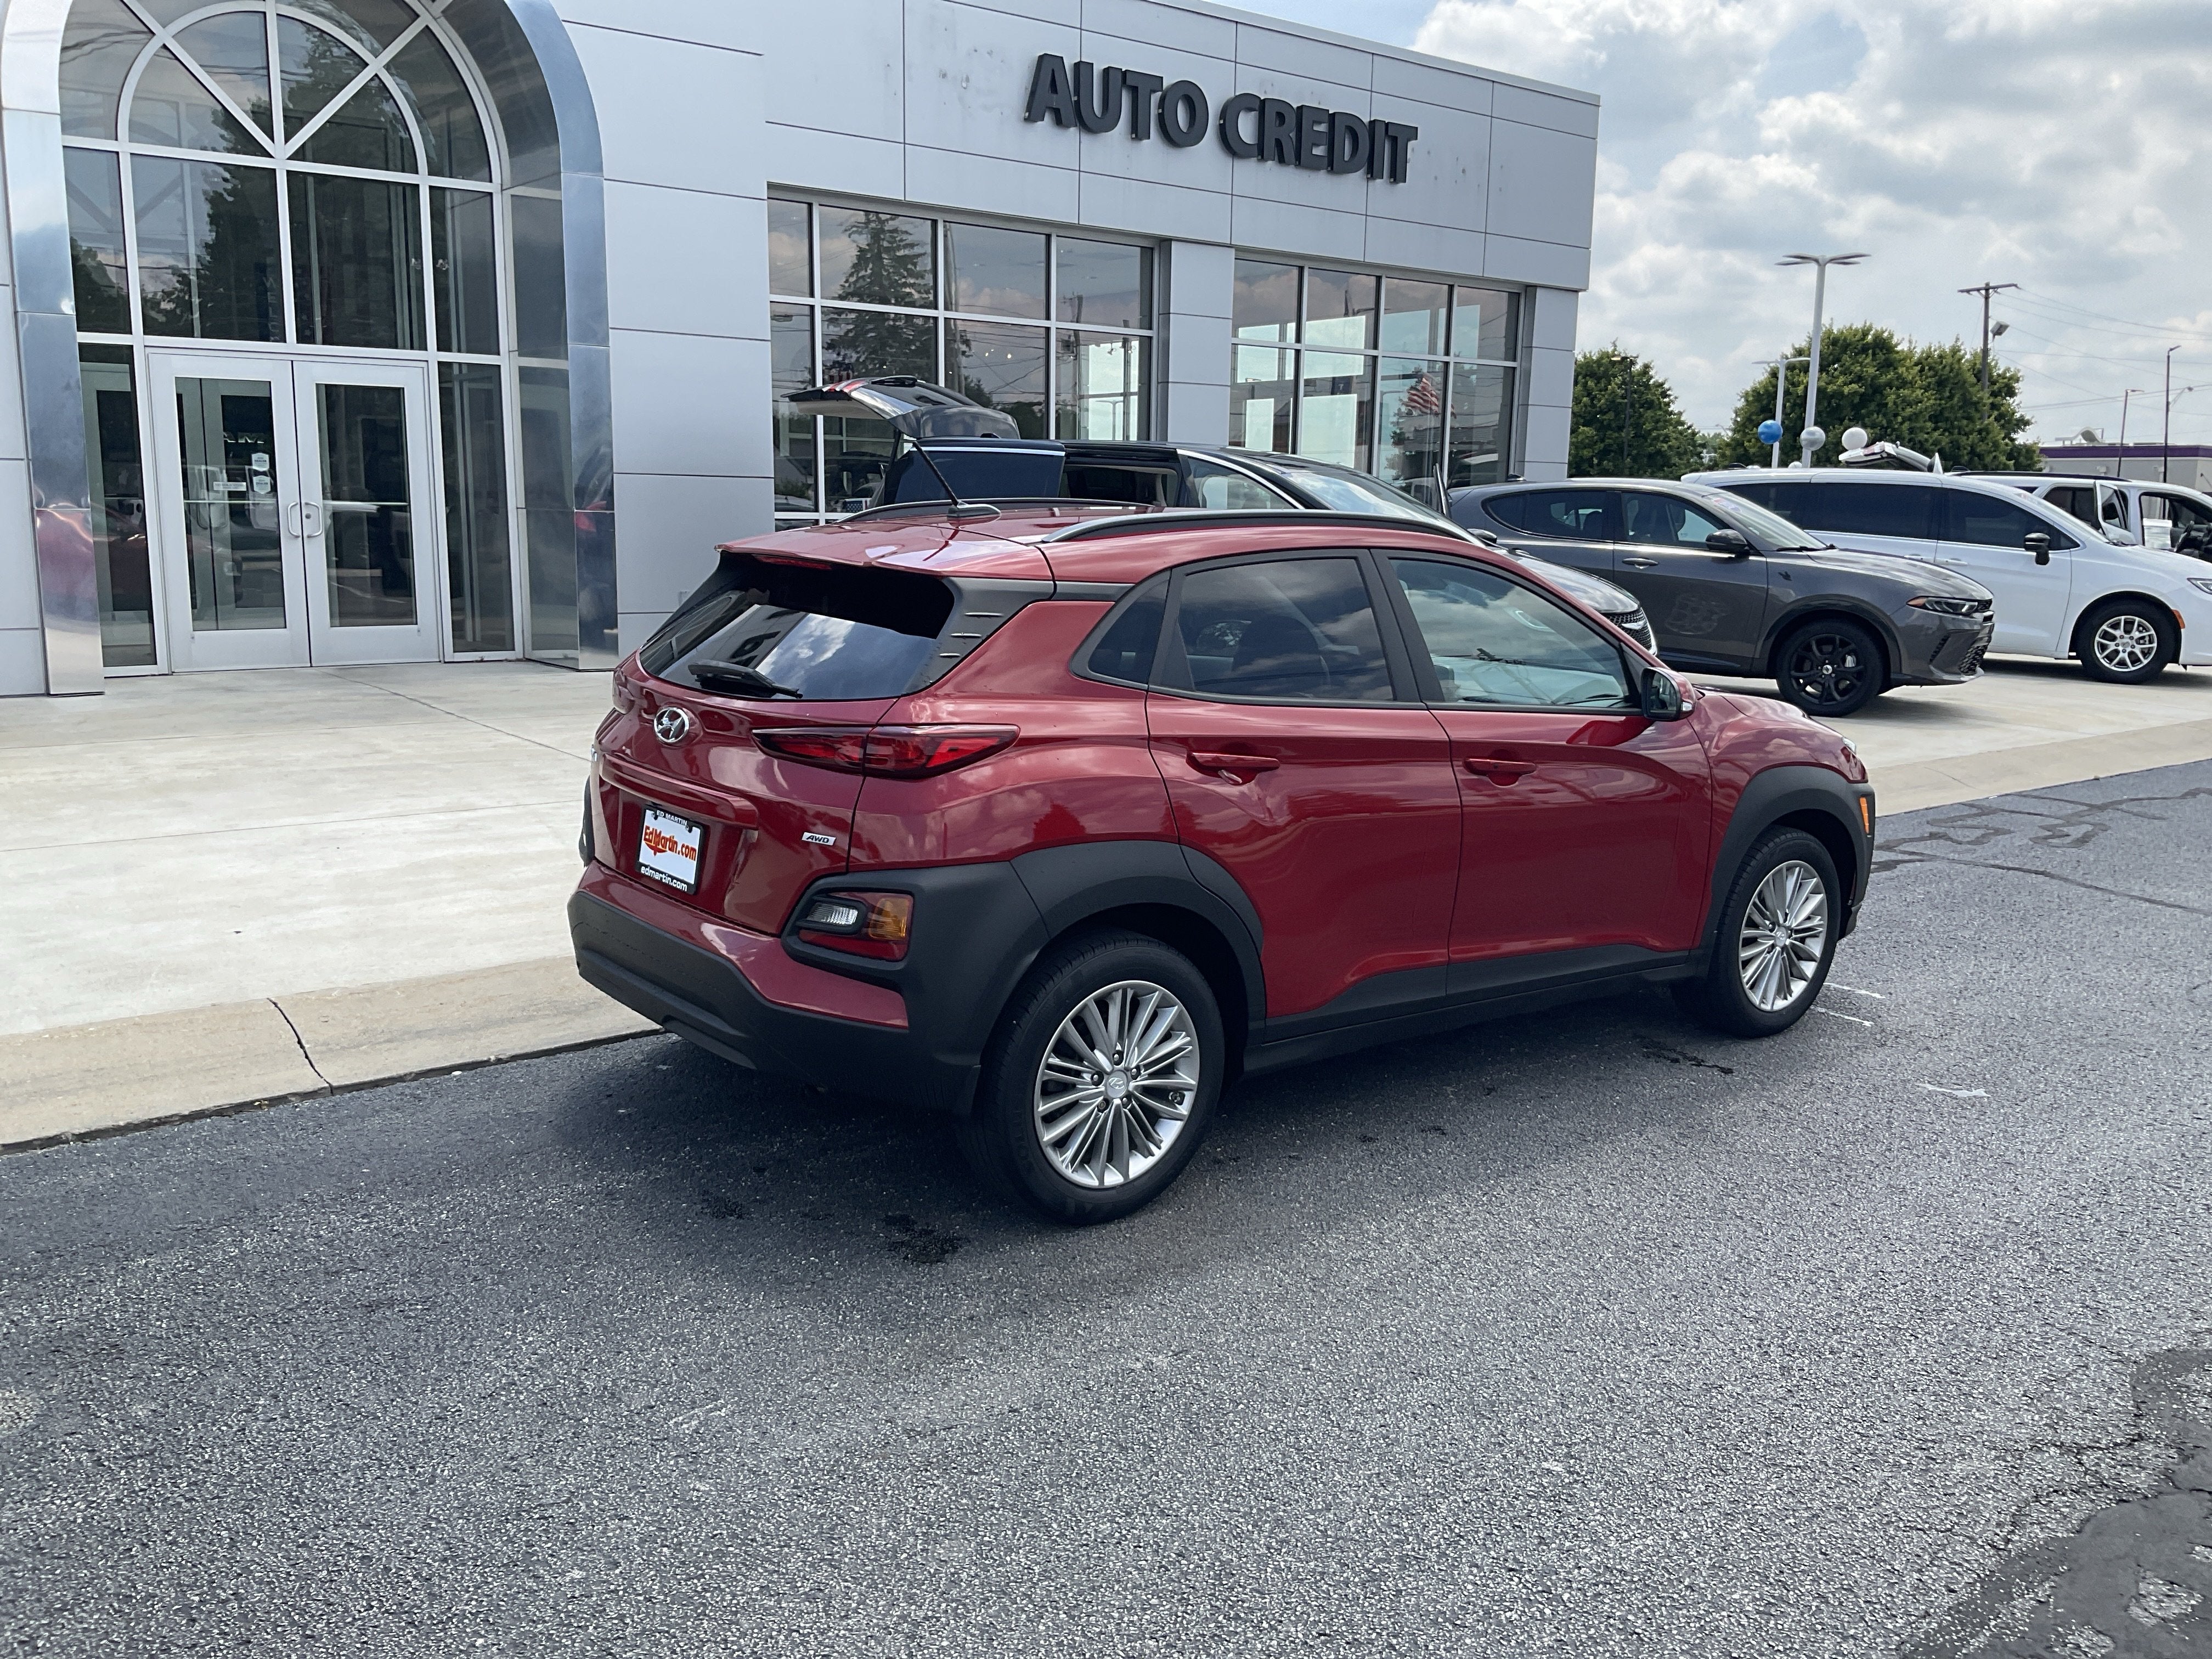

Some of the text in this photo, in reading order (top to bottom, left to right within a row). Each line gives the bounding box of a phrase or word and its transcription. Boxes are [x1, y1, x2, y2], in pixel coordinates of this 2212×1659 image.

[1024, 53, 1418, 183] AUTO CREDIT
[665, 814, 687, 826] MARTIN
[644, 825, 697, 861] EdMartin.com
[806, 835, 830, 843] AWD
[641, 866, 687, 892] edmartin.com
